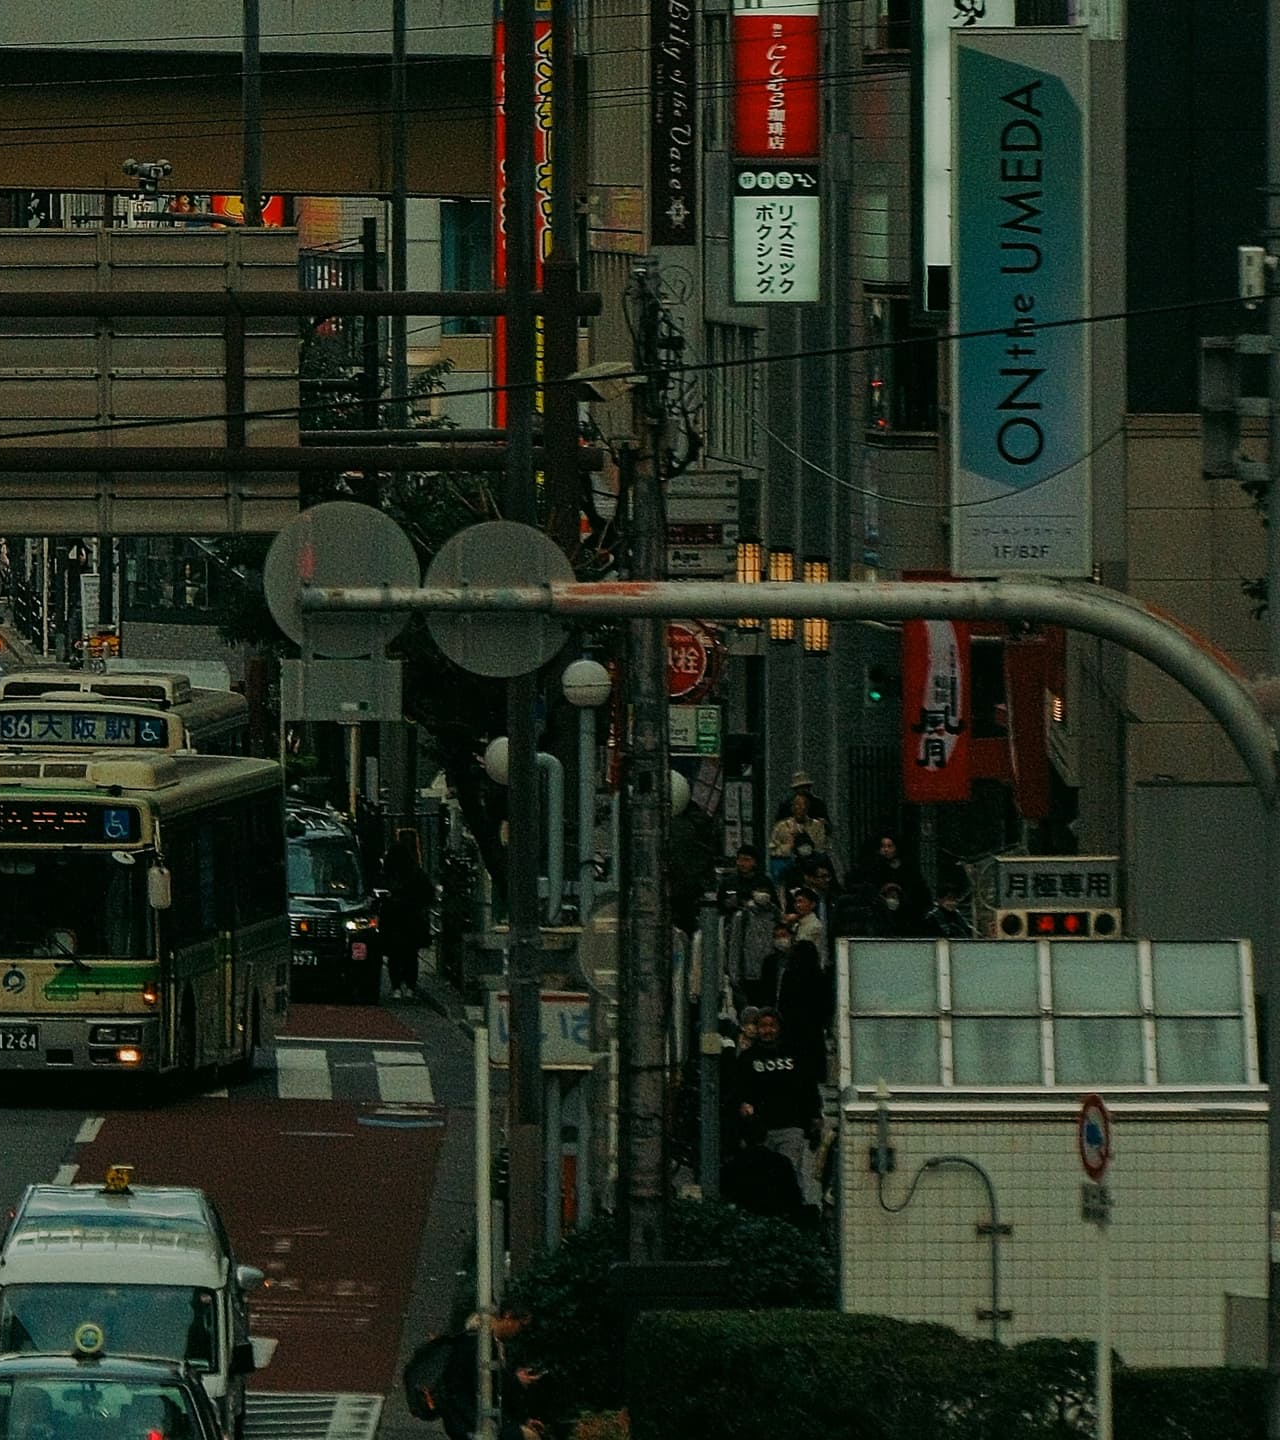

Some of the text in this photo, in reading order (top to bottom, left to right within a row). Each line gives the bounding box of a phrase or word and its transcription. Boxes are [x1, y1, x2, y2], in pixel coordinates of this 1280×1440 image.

[999, 79, 1044, 275] UMEDA
[756, 203, 775, 294] ボクシング
[778, 205, 796, 294] リズミック
[2, 714, 132, 741] 36 大阪駅
[1007, 872, 1112, 899] 月極専用
